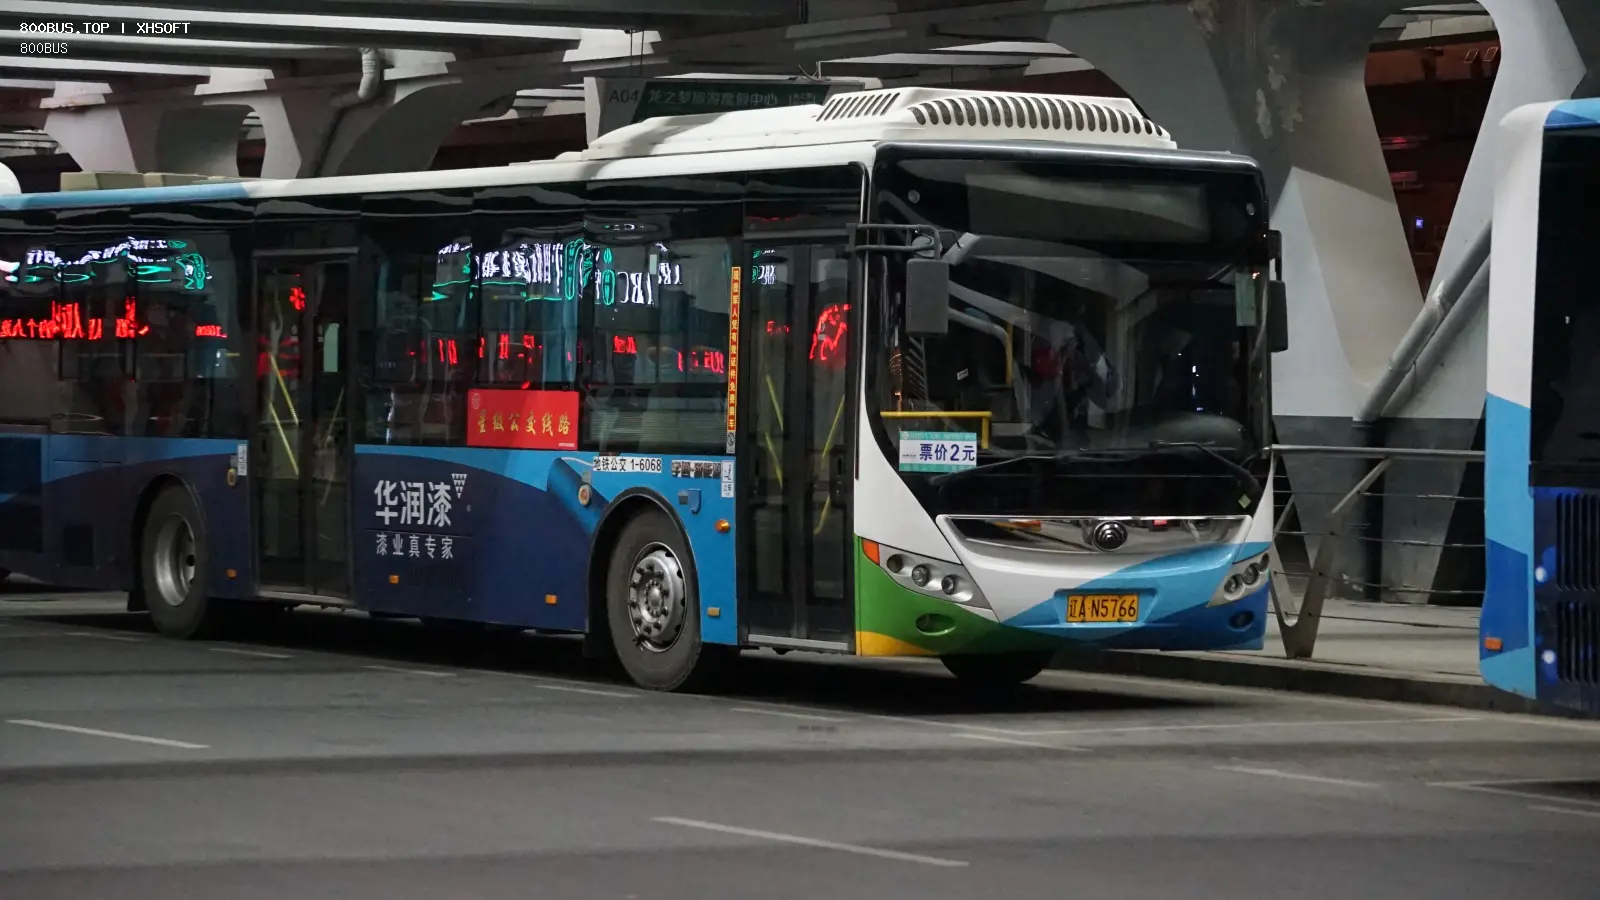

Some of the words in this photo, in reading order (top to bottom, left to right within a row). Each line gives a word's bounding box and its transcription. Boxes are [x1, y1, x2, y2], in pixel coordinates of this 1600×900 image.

[609, 89, 639, 103] A04
[648, 88, 778, 107] 龙之梦旅游度假中心
[478, 409, 571, 437] 星级公交线路
[919, 443, 975, 462] 票价2元
[593, 458, 627, 472] 地铁公交
[630, 458, 662, 472] 1-6068
[374, 479, 452, 528] 华润漆
[376, 532, 454, 560] 漆业真专家
